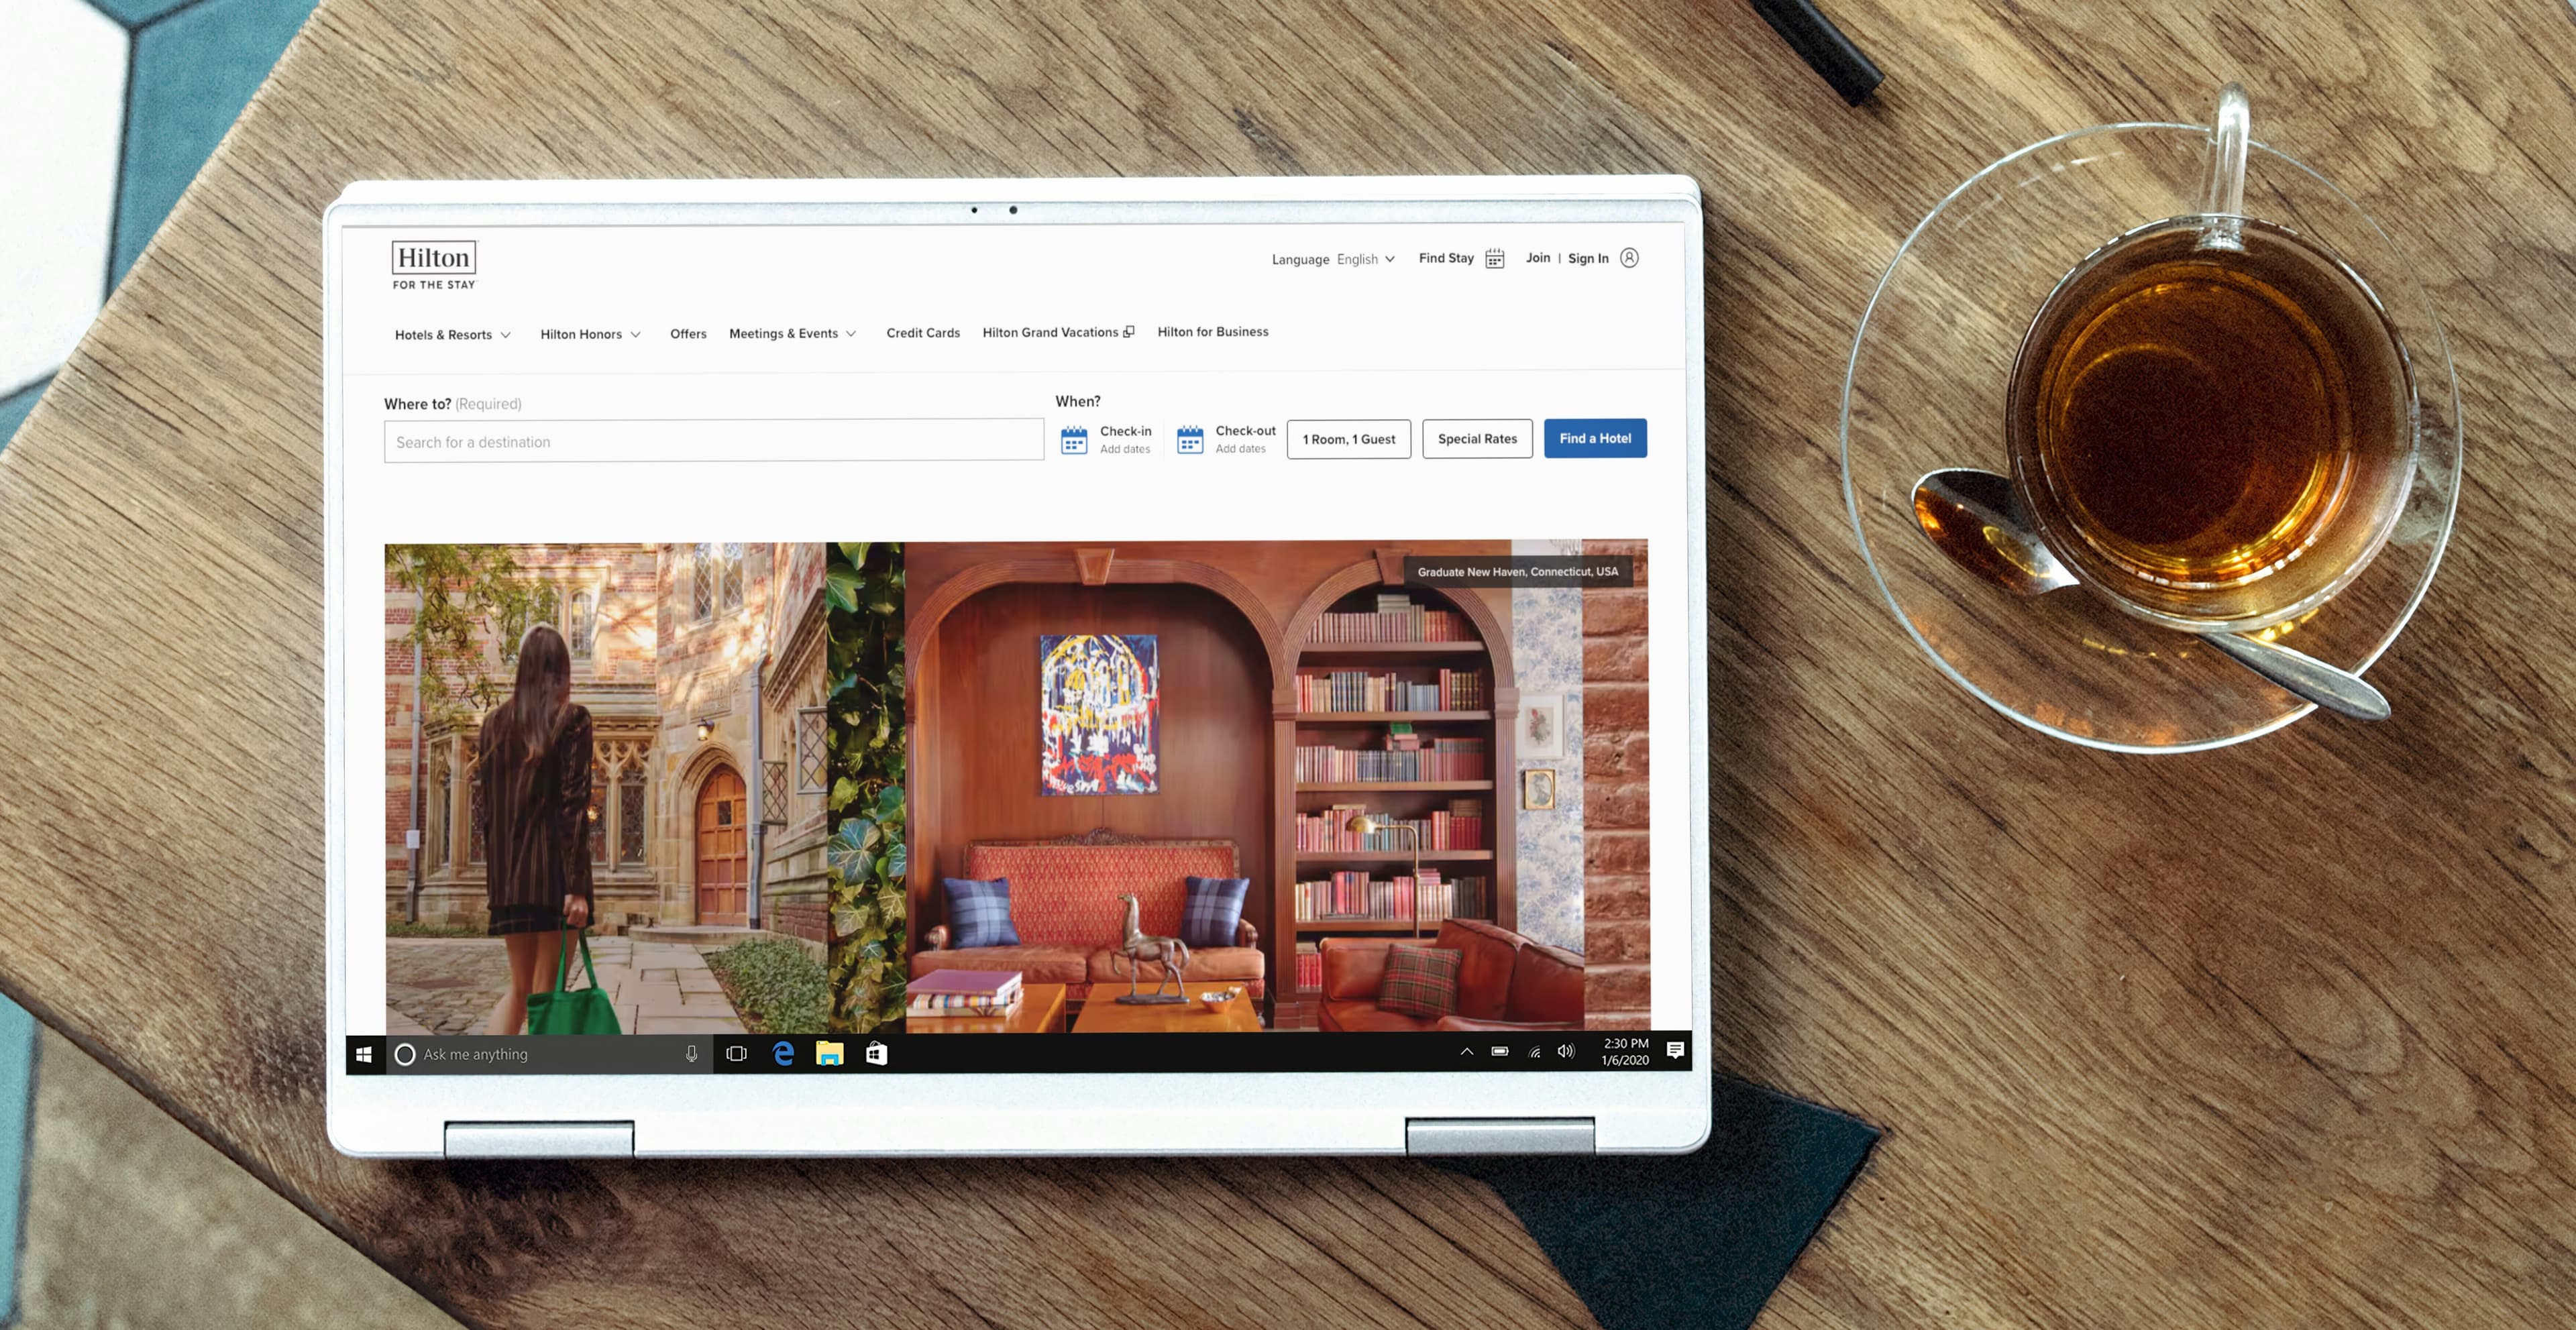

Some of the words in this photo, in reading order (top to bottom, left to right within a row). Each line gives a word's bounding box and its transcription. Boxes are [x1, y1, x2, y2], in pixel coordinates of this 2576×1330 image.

[399, 247, 470, 268] Hilton
[1273, 254, 1330, 268] Language
[1337, 253, 1379, 268] English
[1419, 252, 1446, 264] Find
[1448, 252, 1474, 266] Stay
[1525, 252, 1551, 263] Join
[1568, 252, 1595, 267] Sign
[1598, 253, 1609, 264] In
[392, 280, 416, 290] FOR
[419, 280, 443, 290] THE
[447, 280, 475, 290] STAY
[395, 329, 433, 341] Hotels
[436, 329, 445, 341] &
[448, 329, 492, 340] Resorts
[541, 329, 576, 340] Hilton
[580, 329, 623, 340] Honors
[670, 328, 707, 339] Offers
[729, 327, 784, 341] Meetings
[787, 328, 796, 339] &
[799, 328, 839, 339] Events
[886, 327, 923, 339] Credit
[926, 327, 961, 338] Cards
[983, 327, 1018, 338] Hilton
[1021, 327, 1058, 338] Grand
[1061, 327, 1119, 338] Vacations
[1158, 326, 1193, 337] Hilton
[1196, 326, 1214, 337] for
[1216, 325, 1269, 337] Business
[384, 397, 429, 410] Where
[431, 397, 452, 410] to?
[455, 397, 522, 413] (Required)
[1055, 394, 1101, 408] When?
[1100, 425, 1152, 437] Check-in
[1216, 425, 1277, 436] Check-out
[396, 435, 442, 449] Search
[445, 435, 464, 449] for
[467, 439, 475, 449] a
[478, 435, 551, 449] destination
[1311, 434, 1349, 446] Room,
[1360, 434, 1396, 445] Guest
[1438, 433, 1481, 447] Special
[1485, 433, 1518, 444] Rates
[1560, 432, 1587, 444] Find
[1589, 435, 1597, 444] a
[1599, 432, 1632, 444] Hotel
[1099, 444, 1121, 454] Add
[1123, 444, 1151, 454] dates
[1216, 443, 1236, 453] Add
[1239, 443, 1267, 453] dates
[1418, 567, 1465, 577] Graduate
[1467, 567, 1491, 577] New
[1493, 567, 1528, 579] Haven,
[1530, 567, 1594, 578] Connecticut,
[1596, 566, 1619, 576] USA
[1604, 1038, 1628, 1049] 2:30
[1631, 1038, 1649, 1049] PM
[423, 1048, 446, 1060] Ask
[450, 1051, 470, 1061] me
[473, 1047, 528, 1064] anything
[1601, 1054, 1650, 1067] 1/6/2020
